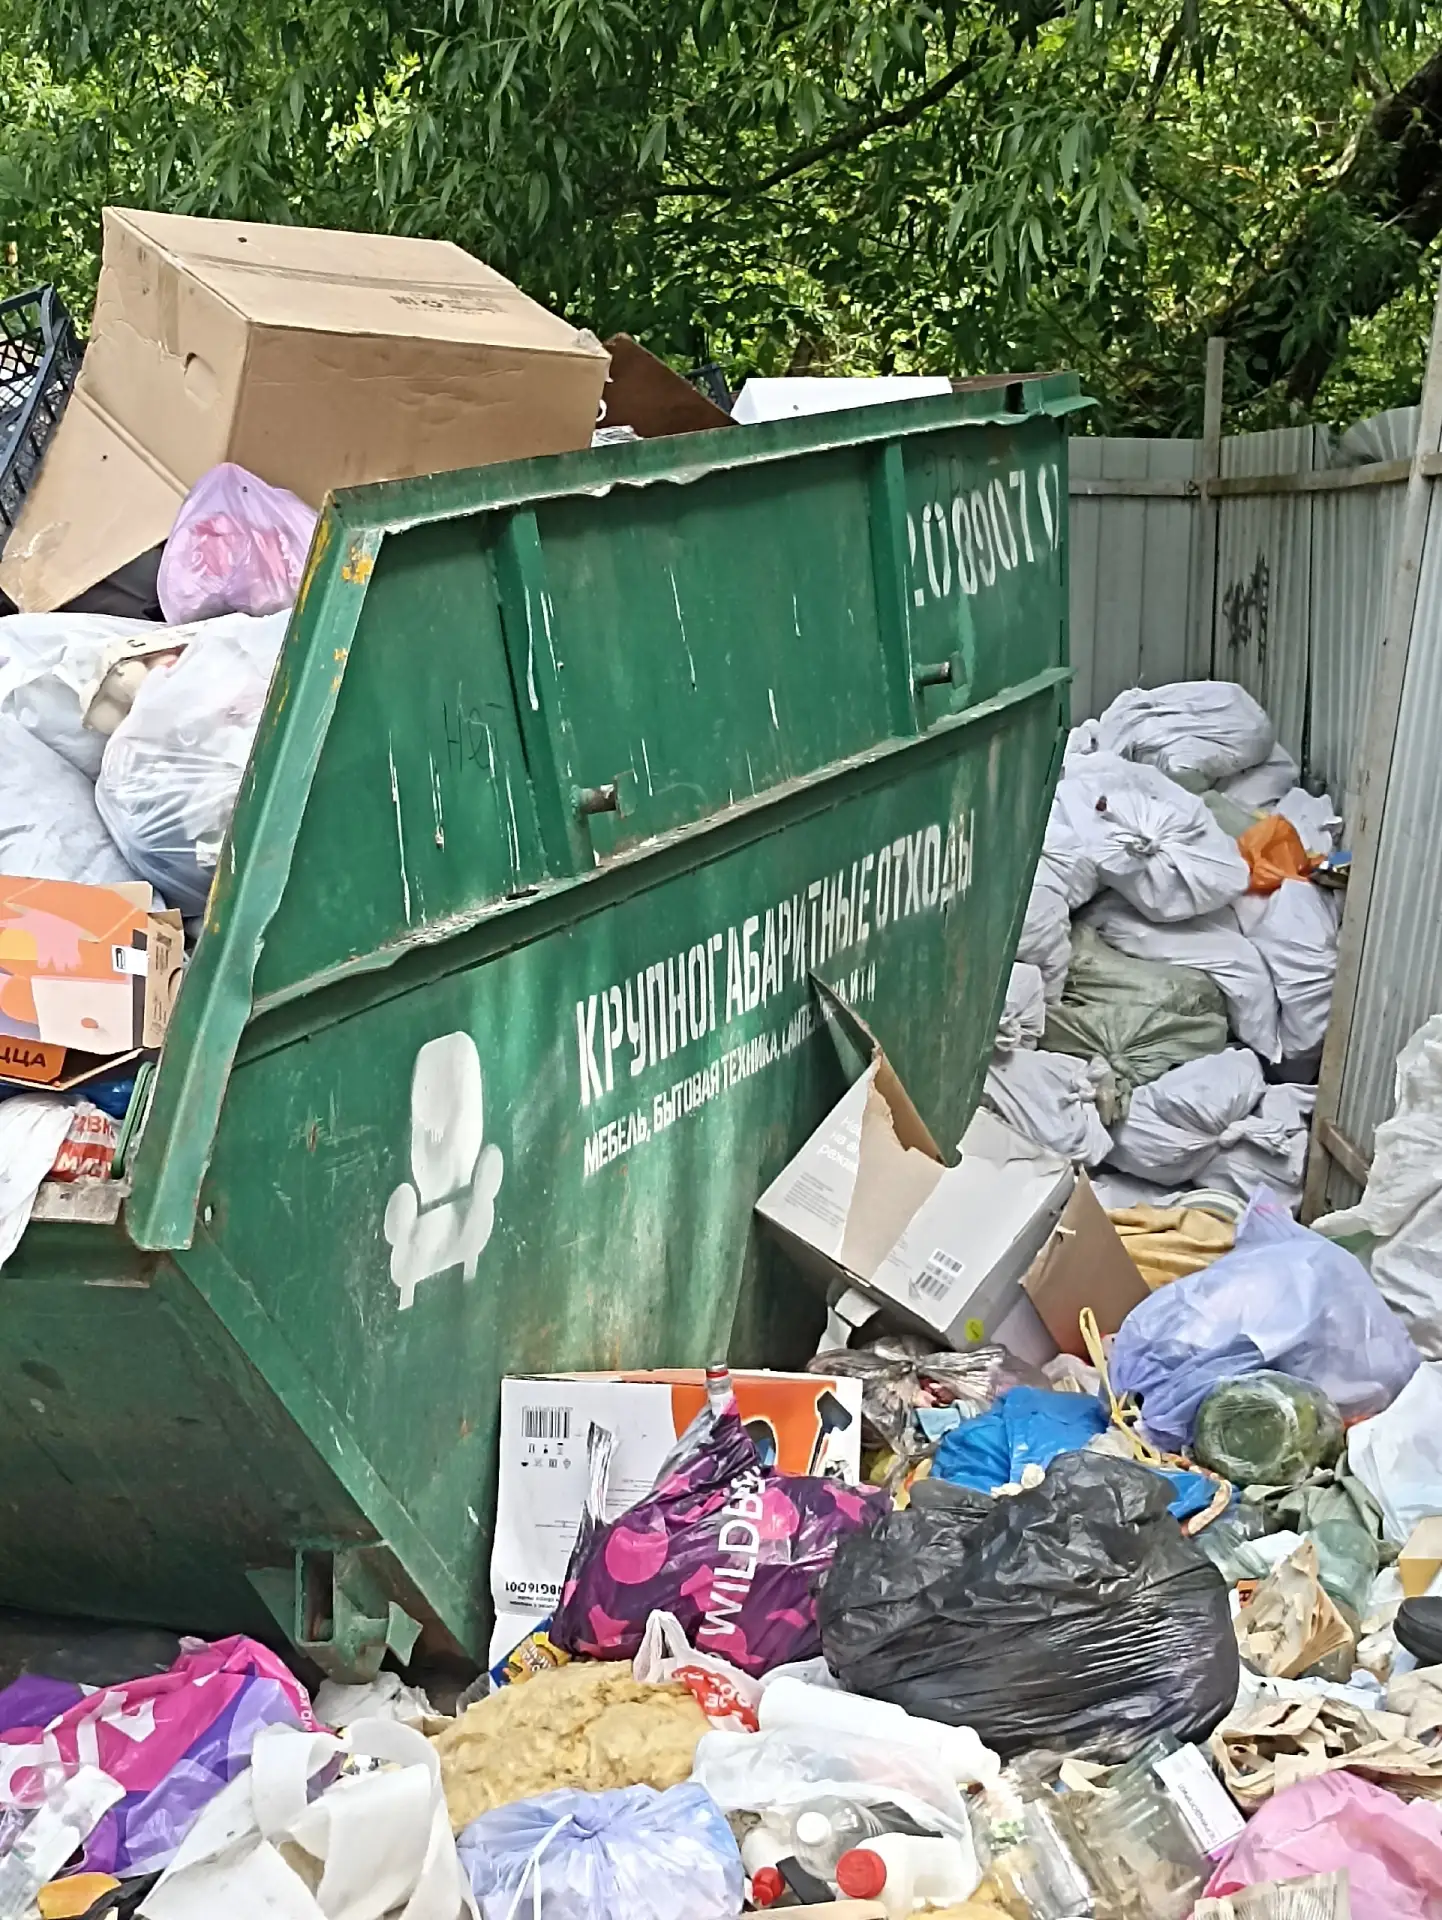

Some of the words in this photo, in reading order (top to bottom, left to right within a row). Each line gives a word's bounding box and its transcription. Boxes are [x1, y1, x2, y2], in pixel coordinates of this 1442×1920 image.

[576, 853, 874, 1107] КРУПНОГАБАРИТНЫЕ
[875, 808, 976, 931] ОТХОДЫ
[653, 1067, 720, 1135] БЫТОВАЯ
[721, 1037, 781, 1090] ТЕХНИКА,
